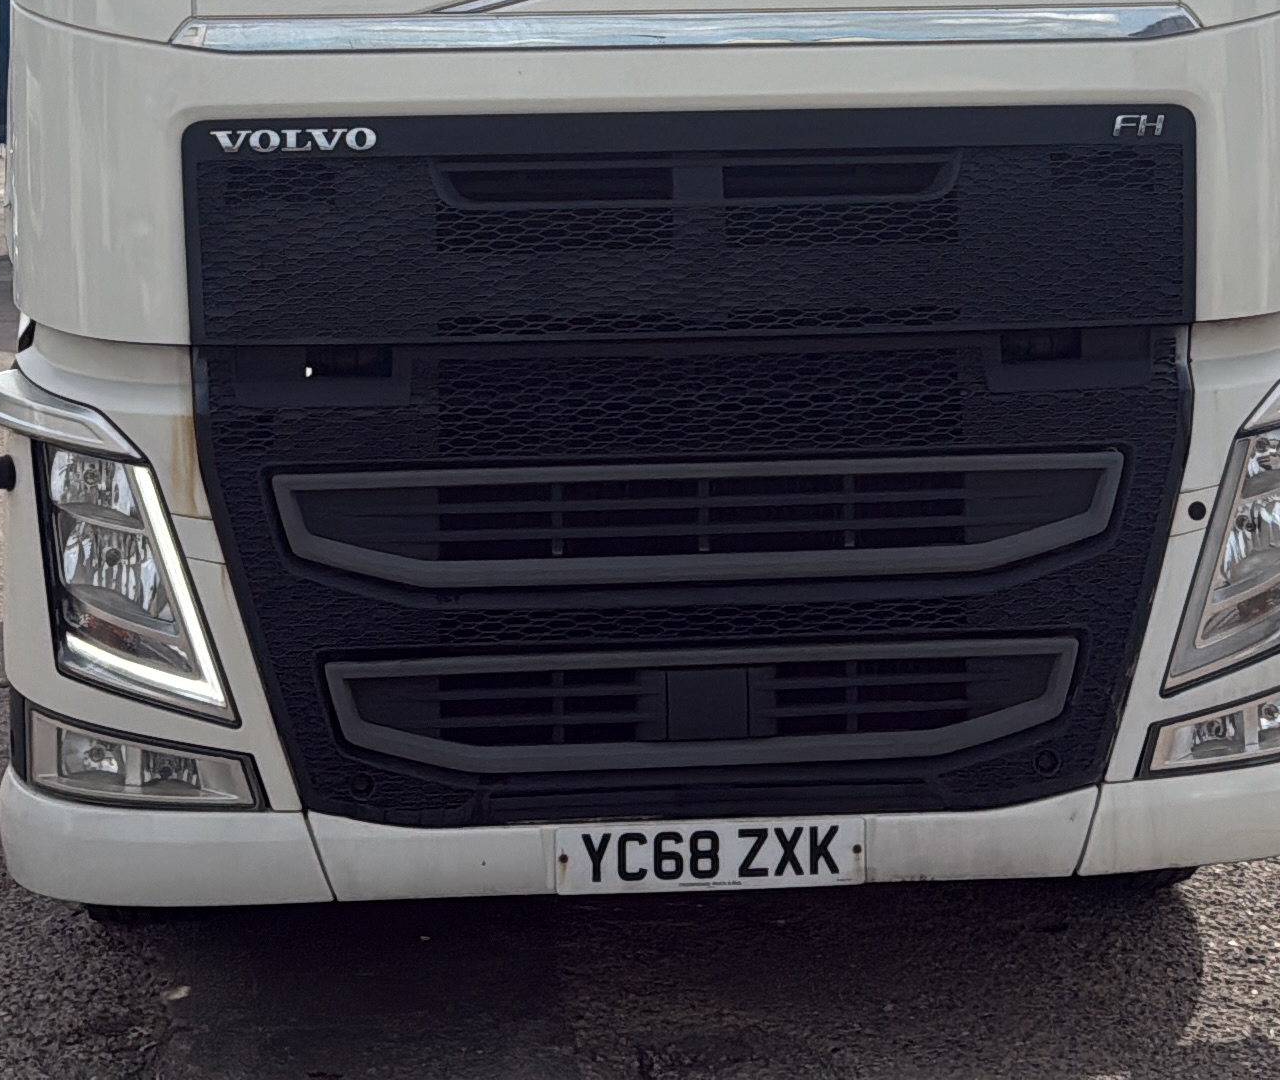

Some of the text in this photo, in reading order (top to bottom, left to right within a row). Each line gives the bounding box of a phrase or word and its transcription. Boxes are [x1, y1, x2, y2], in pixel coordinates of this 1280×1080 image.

[1112, 114, 1165, 137] FH
[209, 127, 377, 153] VOLVO
[581, 824, 840, 883] YC68 ZXK
